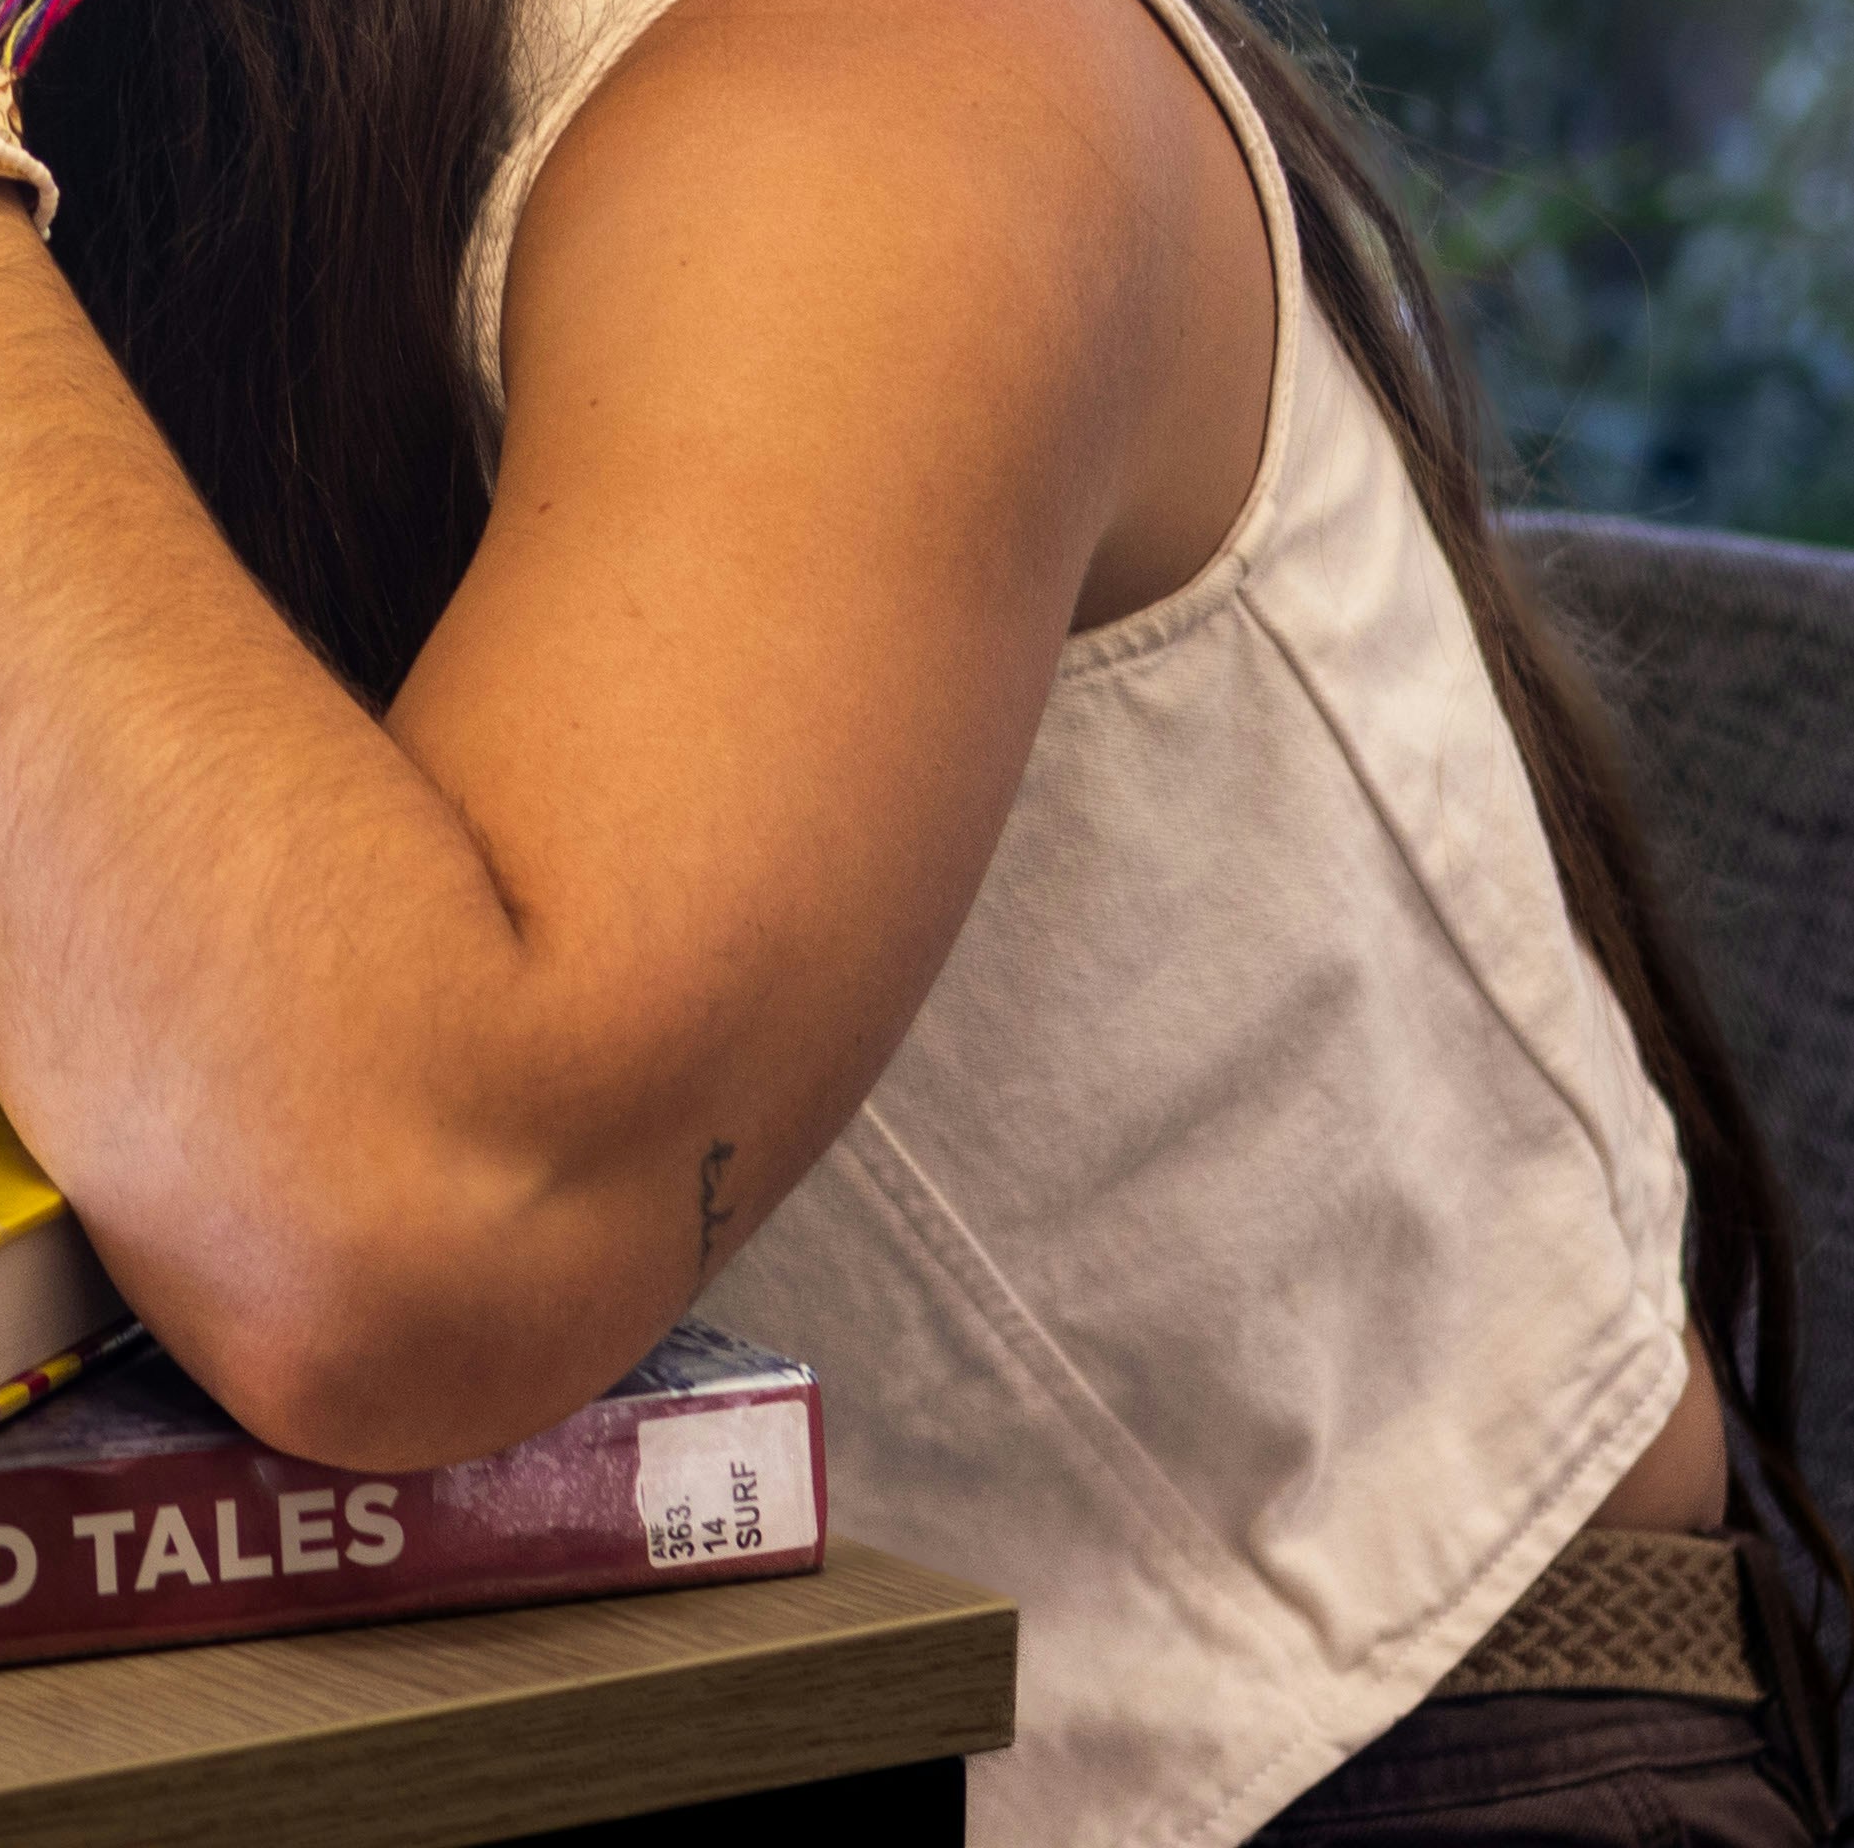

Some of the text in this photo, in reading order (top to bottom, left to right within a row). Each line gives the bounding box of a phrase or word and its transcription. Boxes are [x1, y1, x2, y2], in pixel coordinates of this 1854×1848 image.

[72, 1482, 406, 1597] TALES
[665, 1494, 696, 1560] 363.
[700, 1516, 729, 1554] 14
[730, 1460, 763, 1550] SURF
